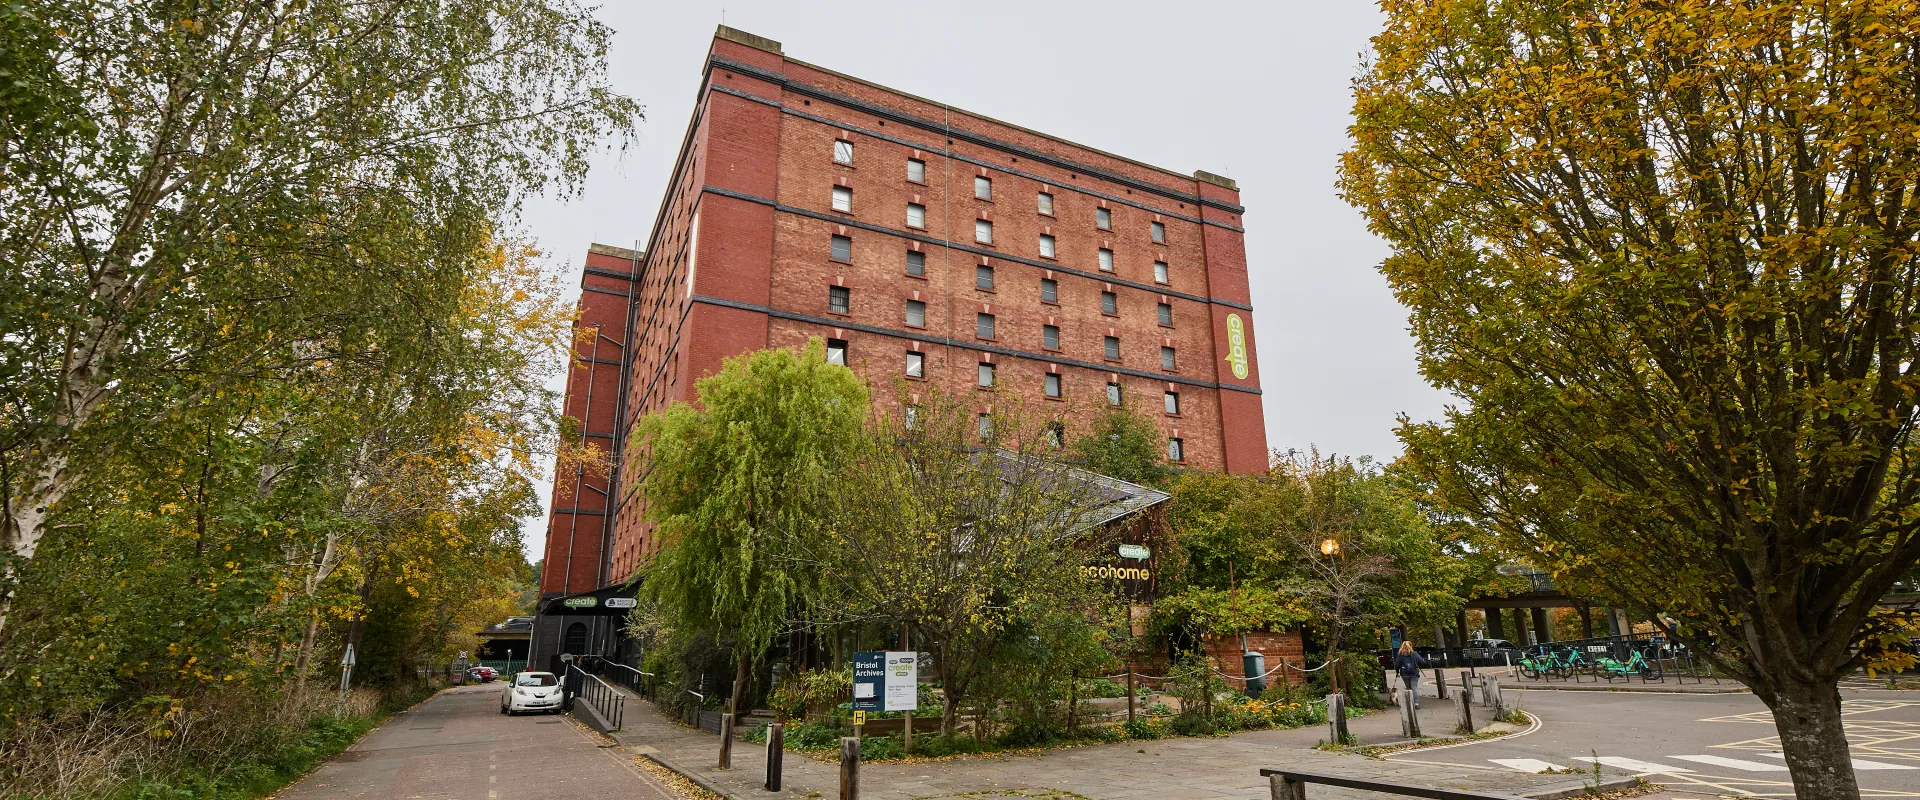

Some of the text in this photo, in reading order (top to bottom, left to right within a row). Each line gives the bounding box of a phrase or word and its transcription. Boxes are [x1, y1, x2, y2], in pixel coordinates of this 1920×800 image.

[1230, 317, 1246, 375] create
[1121, 547, 1149, 556] create
[1078, 564, 1150, 580] ecohome
[856, 712, 863, 723] H
